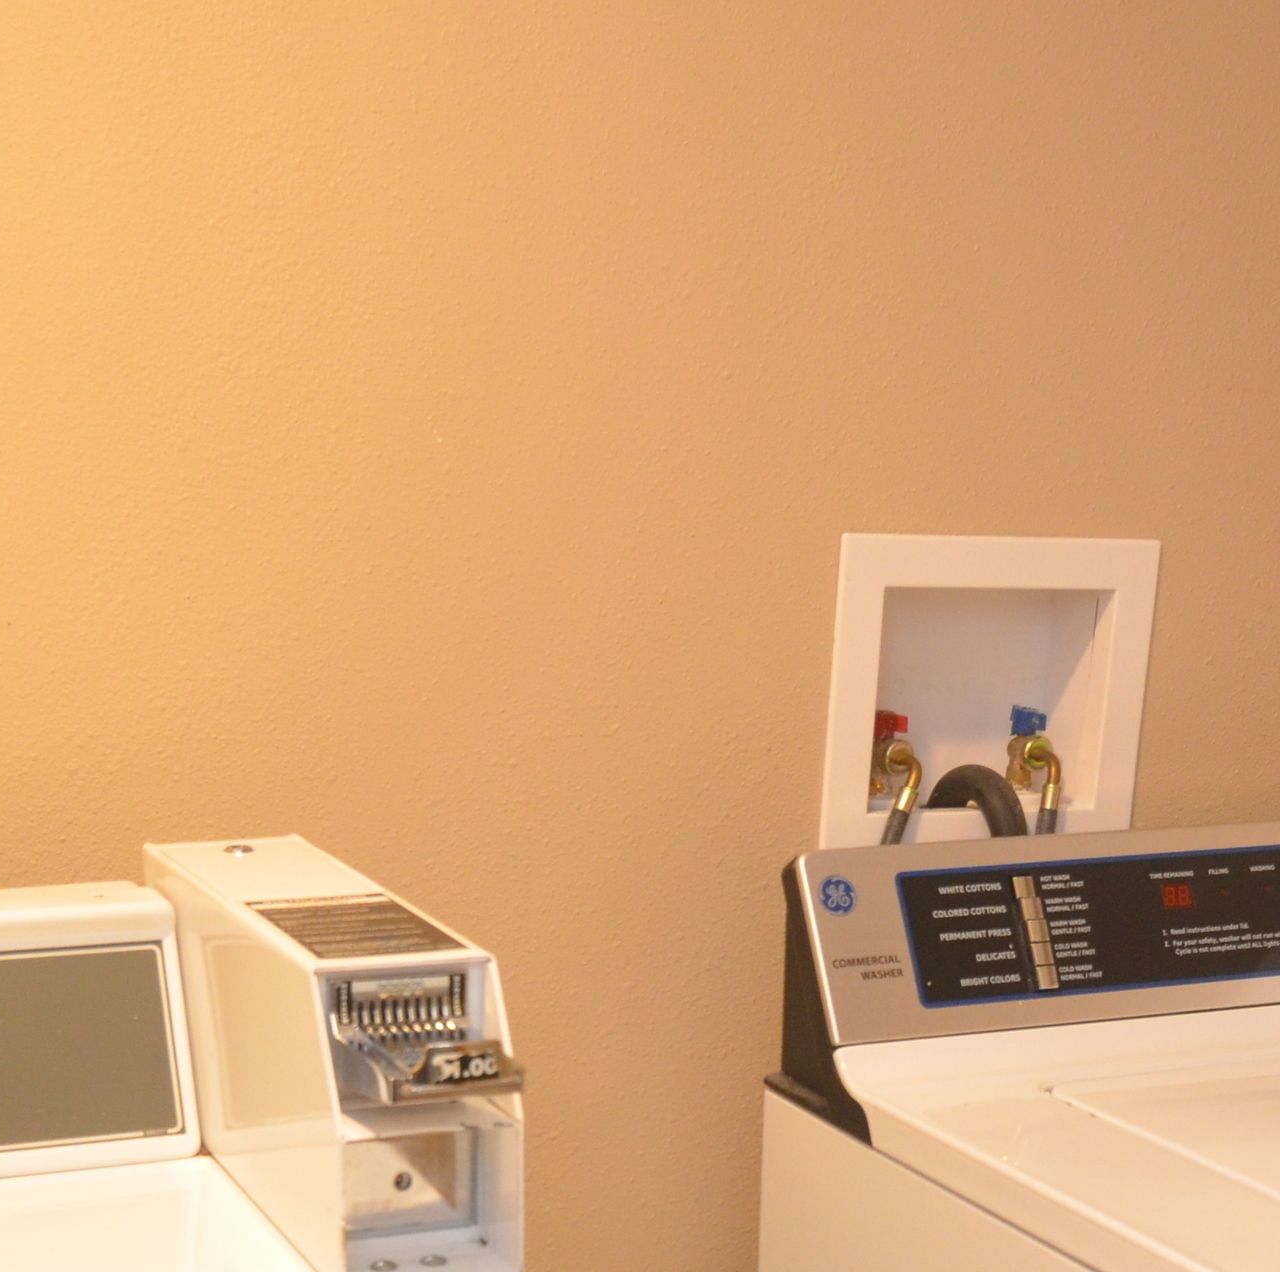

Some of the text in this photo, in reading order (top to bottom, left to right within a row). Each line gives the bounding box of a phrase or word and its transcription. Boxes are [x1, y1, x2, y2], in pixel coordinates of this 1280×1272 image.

[1207, 867, 1229, 875] FILLING
[1249, 864, 1275, 872] WASHING
[1052, 873, 1070, 881] WASH
[1163, 870, 1194, 878] REMAINING
[937, 882, 1002, 895] WHITE COTTONS
[1041, 882, 1066, 890] NORMAL
[1070, 880, 1084, 888] FAST
[1044, 897, 1063, 905] WARM
[932, 905, 1007, 919] COLORED COTTONS
[1046, 904, 1071, 912] NORMAL
[1049, 918, 1086, 928] WARM WASH
[1051, 927, 1072, 935] GENTLE
[1170, 927, 1186, 935] Read
[1186, 925, 1221, 934] instructions
[1222, 923, 1239, 931] under
[939, 928, 1012, 941] PERMANENT PRESS
[1054, 941, 1088, 951] COLD WASH
[1183, 939, 1197, 947] your
[1198, 937, 1218, 945] safety,
[1218, 935, 1240, 943] washer
[1055, 950, 1077, 958] GENTLE
[1081, 948, 1096, 956] FAST
[1175, 947, 1192, 956] Cycle
[1209, 943, 1237, 952] complete
[1237, 941, 1251, 950] until
[1251, 940, 1263, 948] ALL
[975, 950, 1016, 962] DELICATES
[832, 954, 902, 969] COMMERCIAL
[1075, 964, 1093, 972] WASH
[860, 968, 904, 981] WASHER
[1060, 973, 1084, 981] NORMAL
[1088, 971, 1102, 979] FAST
[960, 973, 1021, 987] BRIGHT COLORS
